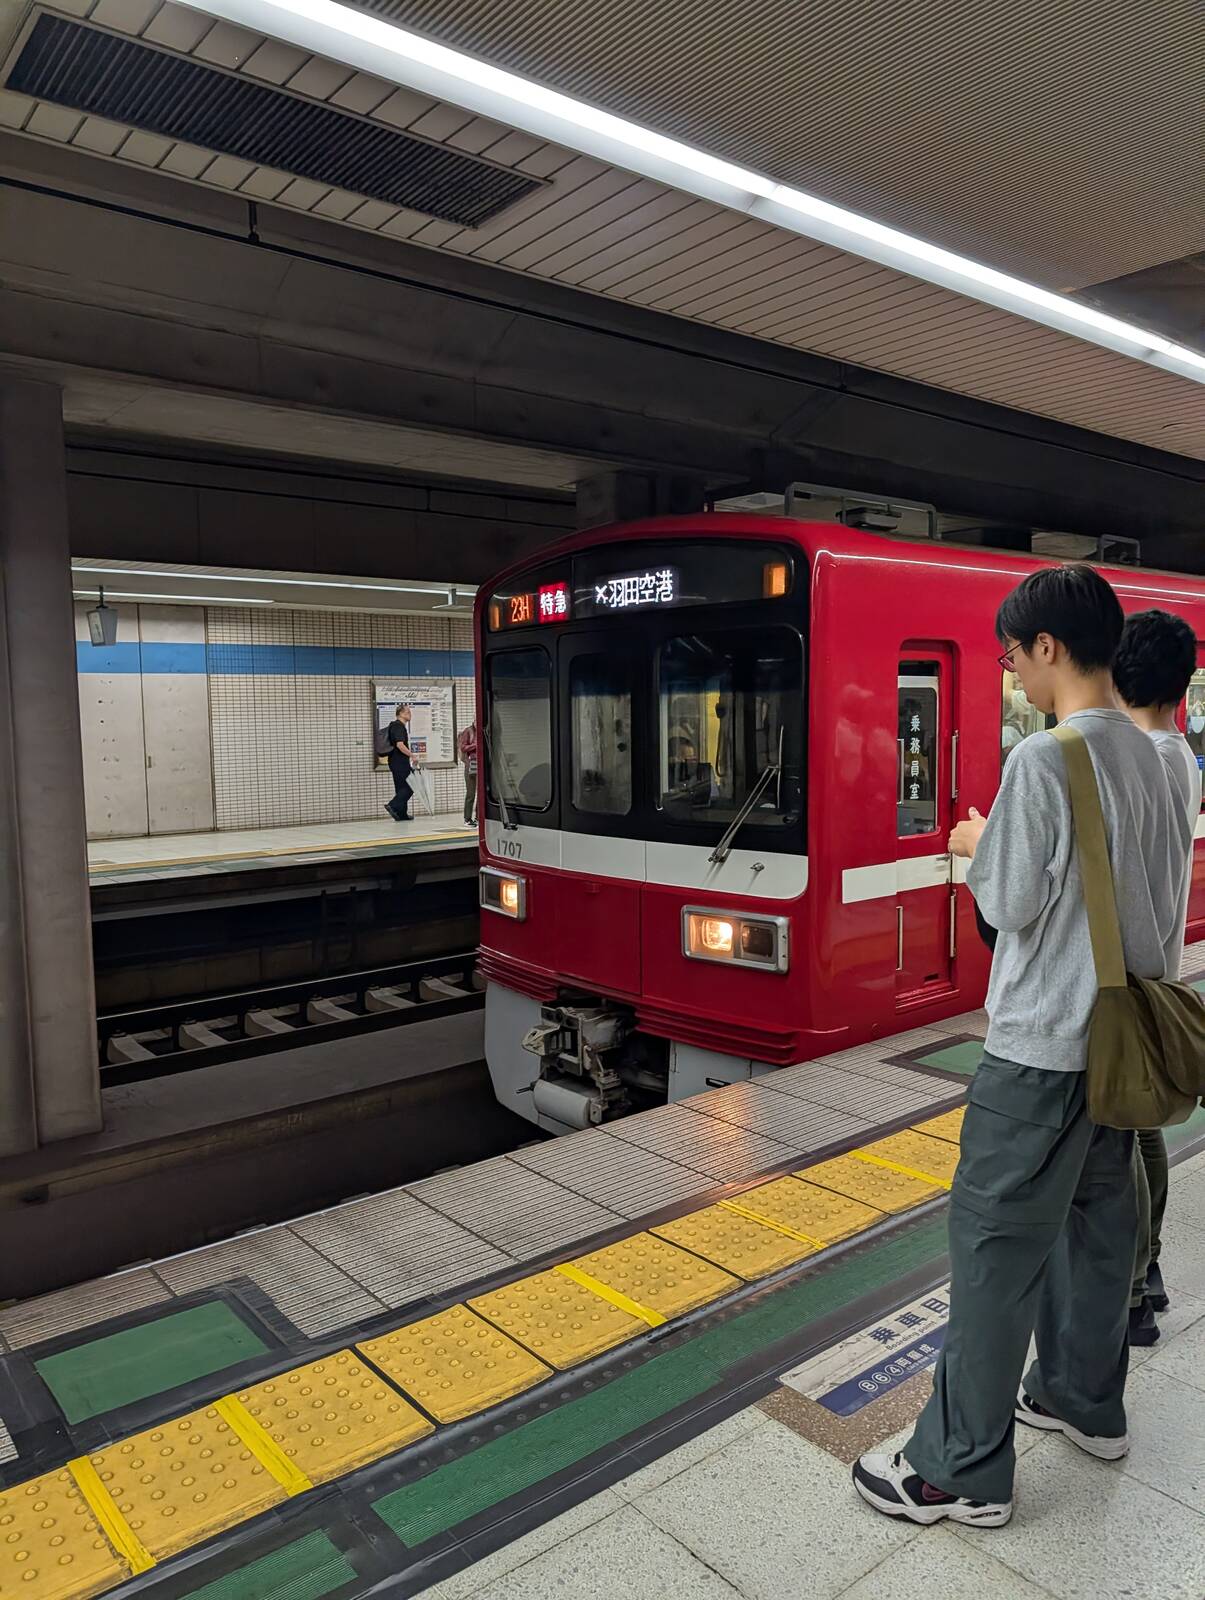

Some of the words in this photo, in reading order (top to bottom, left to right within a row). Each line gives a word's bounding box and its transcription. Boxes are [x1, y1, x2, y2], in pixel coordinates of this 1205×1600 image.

[608, 570, 673, 607] 羽田空港
[510, 594, 530, 622] 23H
[540, 589, 567, 616] 特急
[910, 715, 921, 800] 乗務員室
[496, 838, 522, 859] 1707
[886, 1331, 920, 1351] Boarding
